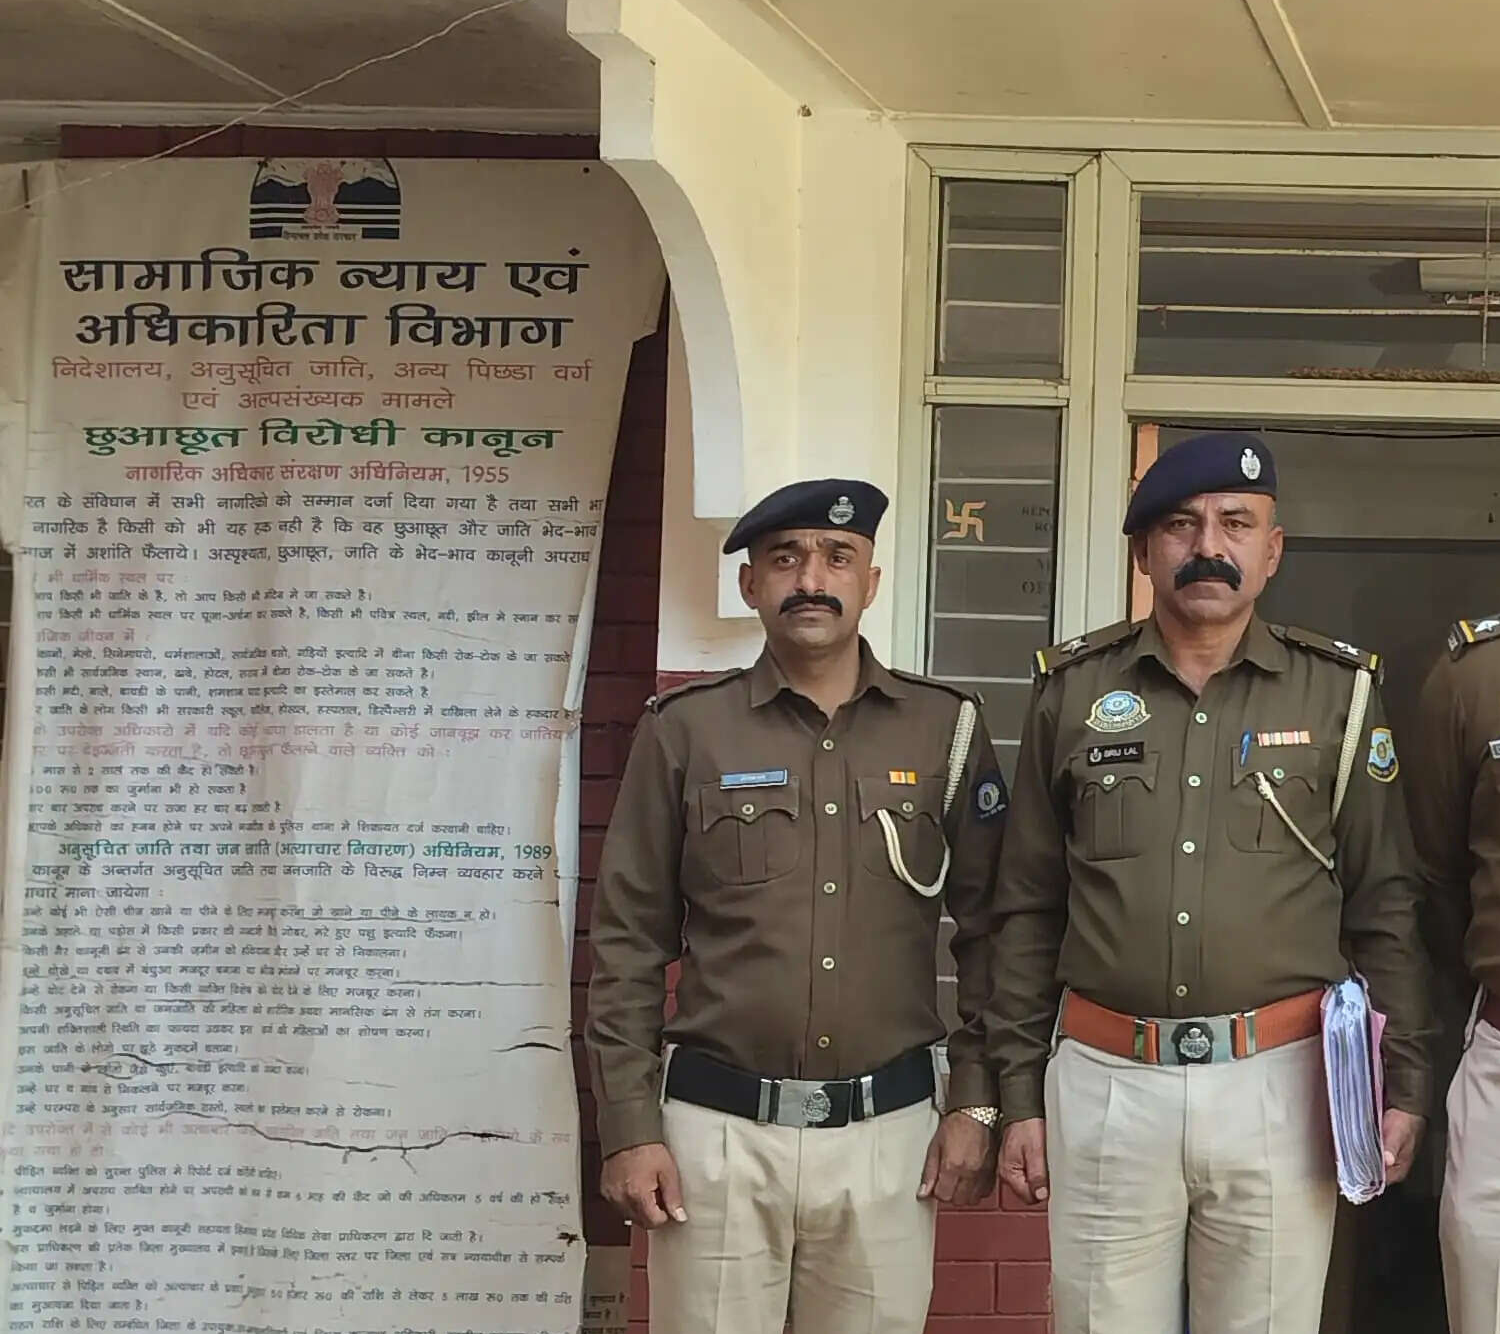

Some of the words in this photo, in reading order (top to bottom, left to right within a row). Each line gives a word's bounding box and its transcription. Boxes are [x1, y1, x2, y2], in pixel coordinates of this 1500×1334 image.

[60, 248, 320, 292] सामाजिक
[336, 261, 487, 292] न्याय
[505, 248, 589, 297] एवं
[76, 302, 367, 347] अधिकारिता
[385, 303, 574, 348] विभाग
[52, 356, 171, 380] निदेशालय,
[309, 356, 373, 380] जाति,
[394, 363, 449, 379] अन्य
[552, 359, 592, 381] वर्ग
[181, 387, 219, 409] एवं
[238, 387, 364, 409] अल्पसंख्यक
[382, 387, 456, 409] मामले
[83, 427, 248, 456] छुआछूत
[258, 418, 406, 446] विरोधी
[421, 428, 563, 457] कानून
[125, 460, 204, 481] नागरिक
[212, 462, 275, 482] अधिकार
[280, 459, 342, 480] संरक्षण
[349, 461, 449, 484] अधिनियम,
[460, 465, 509, 483] 1955
[515, 840, 553, 861] 1989
